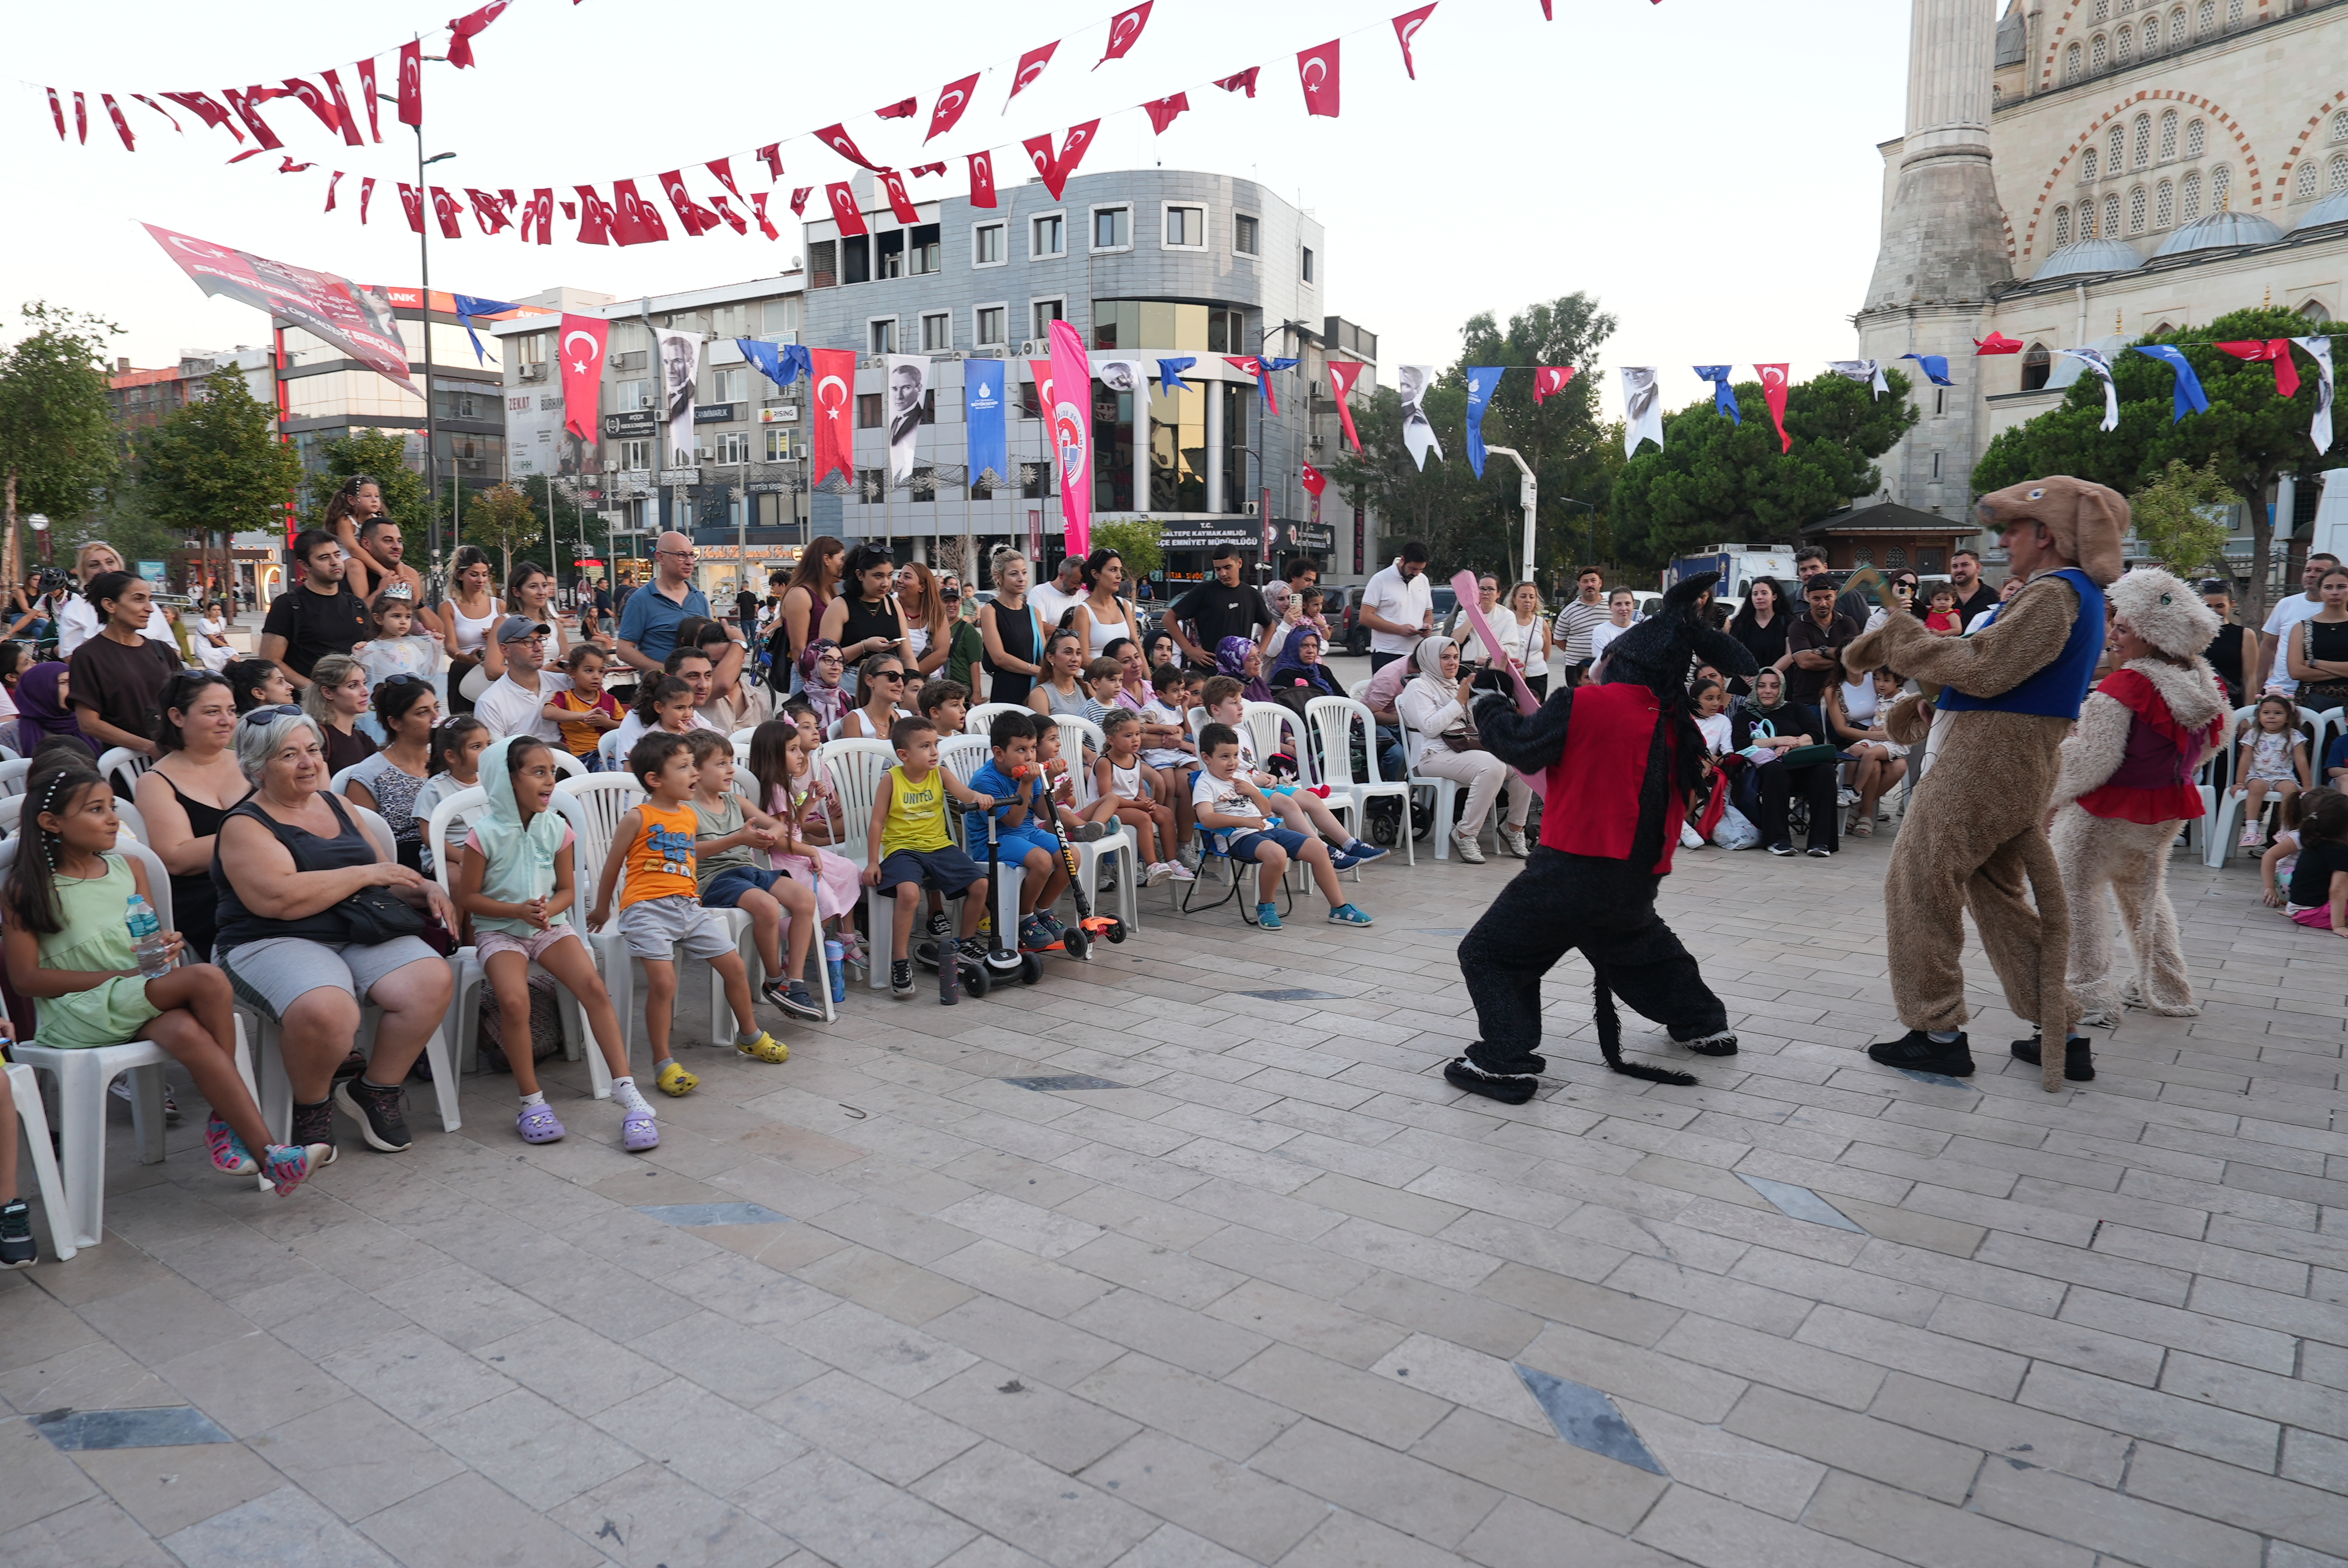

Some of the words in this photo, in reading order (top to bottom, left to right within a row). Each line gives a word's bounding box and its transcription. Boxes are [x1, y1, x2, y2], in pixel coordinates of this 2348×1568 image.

[773, 409, 794, 417] RISING
[1192, 529, 1247, 537] KAYMAKAMLIĞI
[1171, 538, 1207, 546] EMNİYET
[1208, 537, 1258, 546] MÜDÜRLÜĞÜ
[904, 789, 933, 804] UNITED
